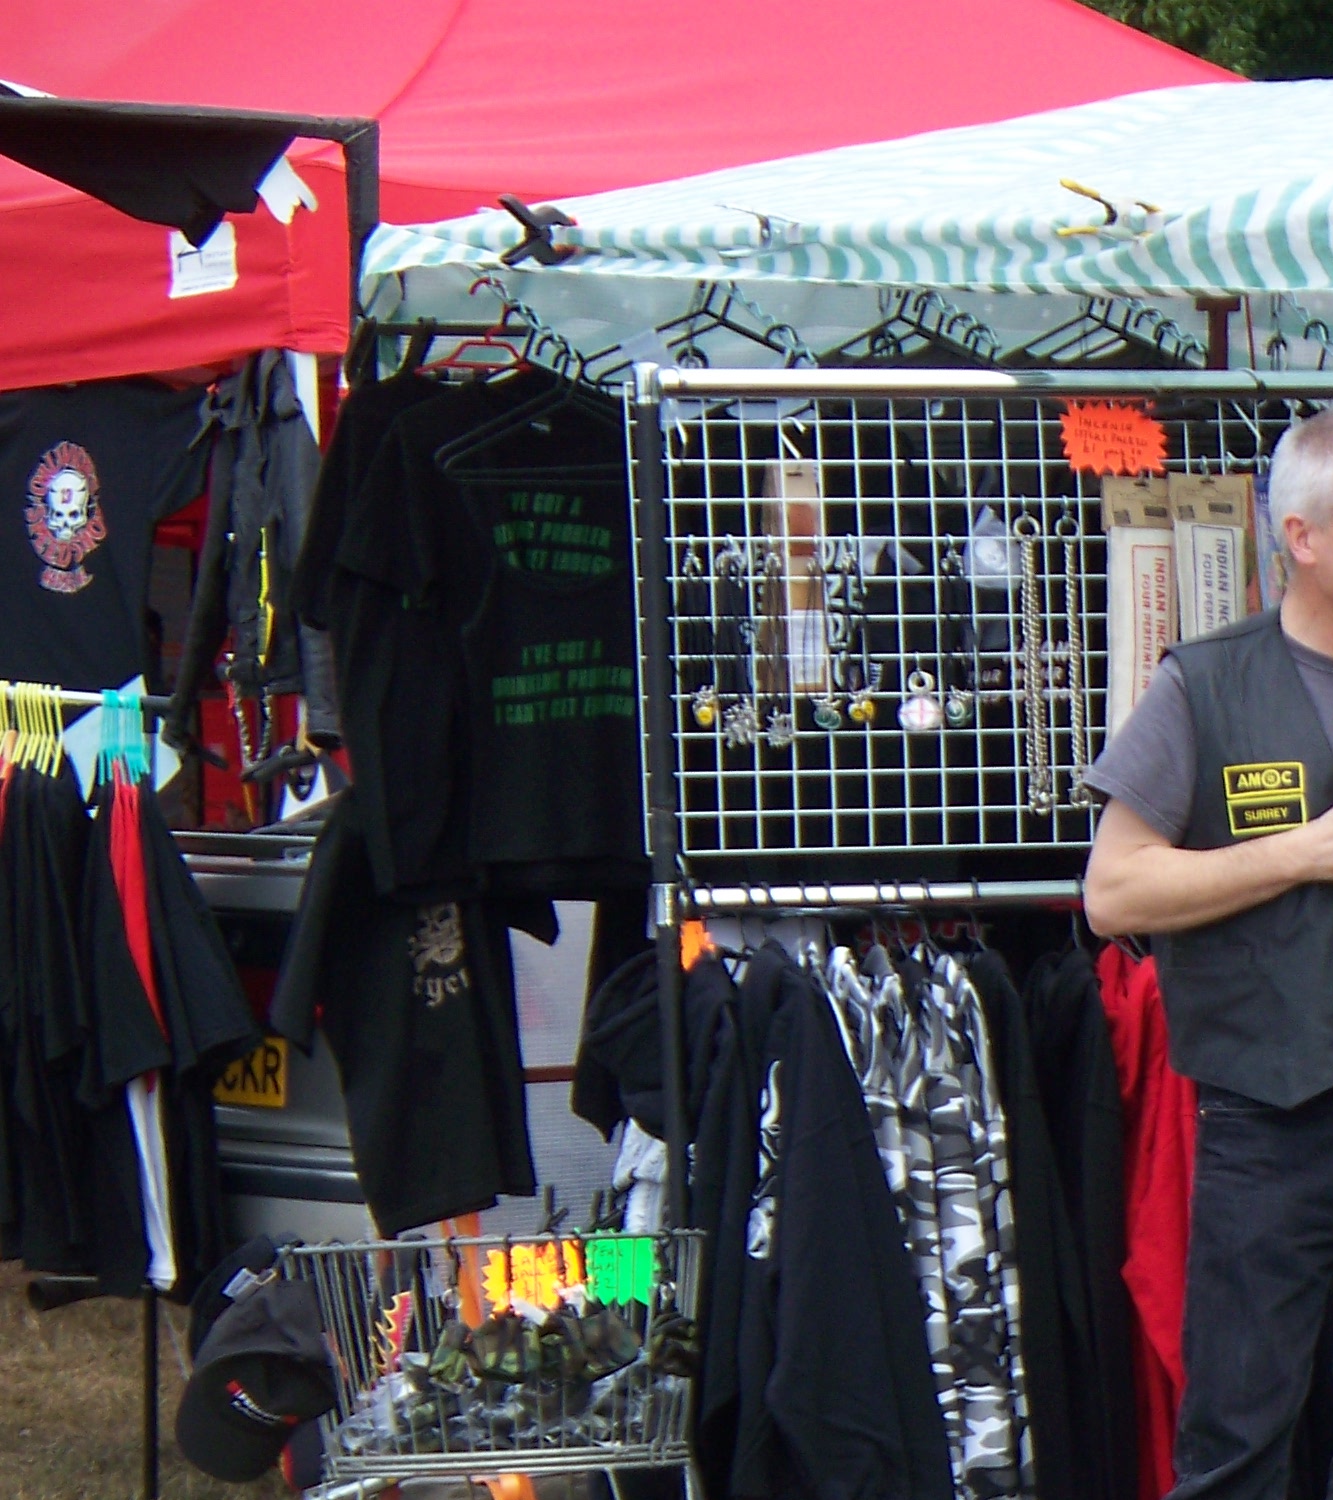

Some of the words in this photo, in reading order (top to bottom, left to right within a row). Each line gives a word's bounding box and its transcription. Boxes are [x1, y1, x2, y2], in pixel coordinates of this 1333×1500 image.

[1155, 557, 1166, 612] INDIAN
[1216, 539, 1228, 592] INDIAN
[1244, 807, 1288, 821] SURREY
